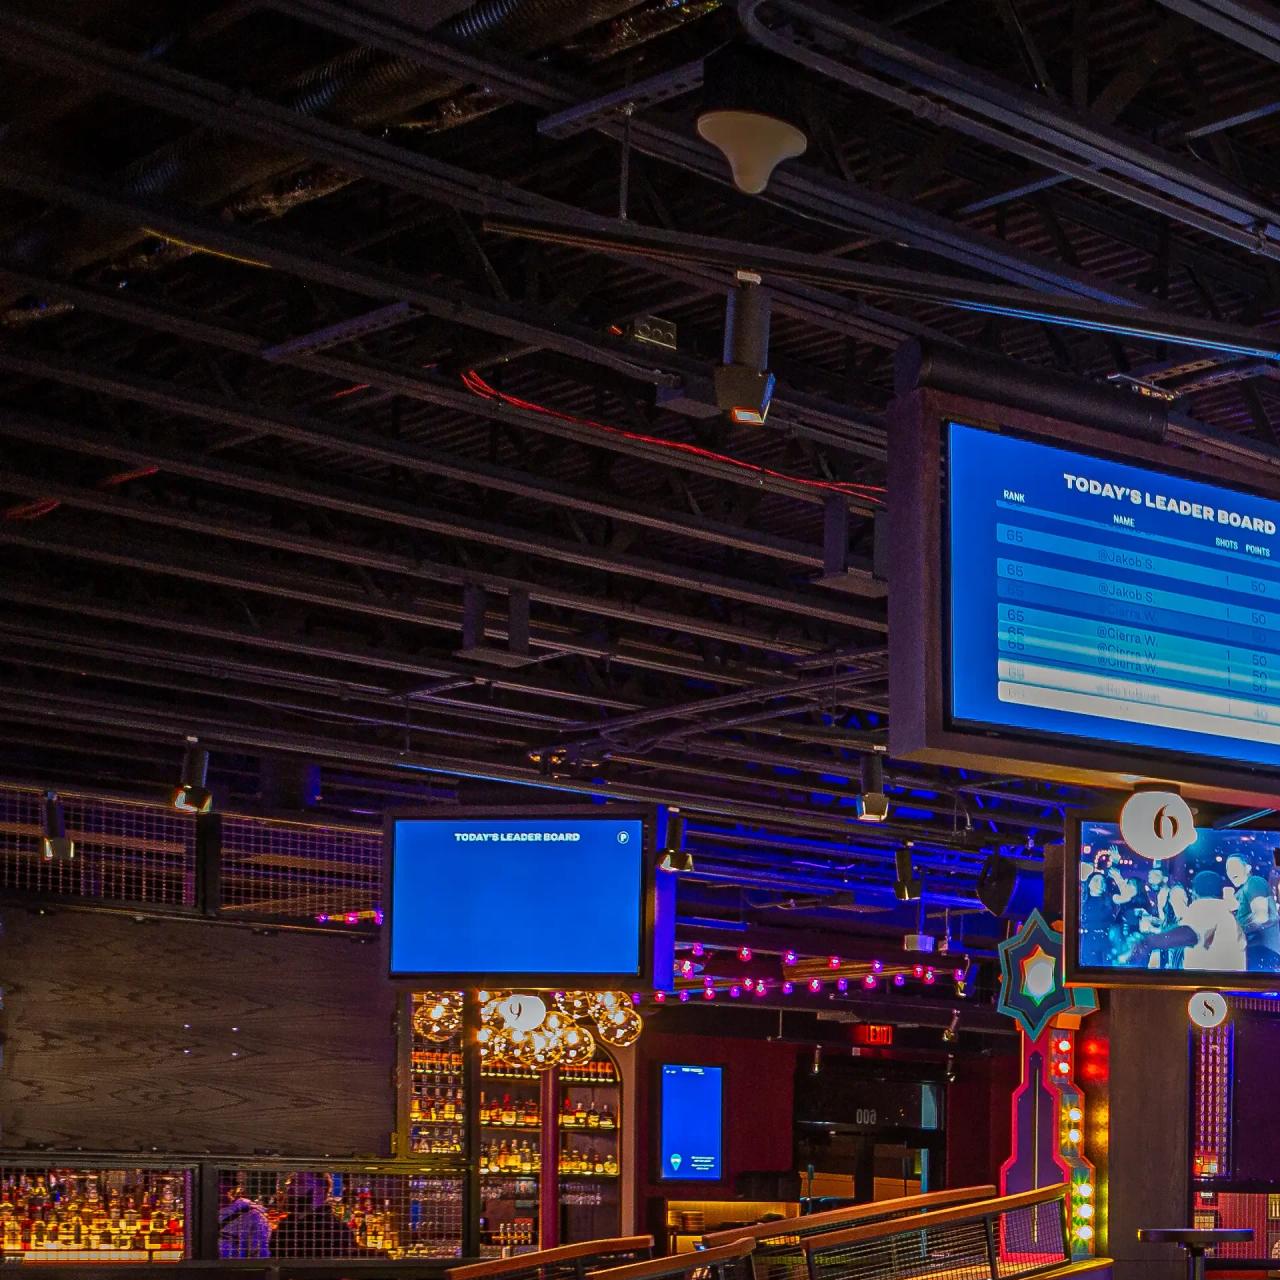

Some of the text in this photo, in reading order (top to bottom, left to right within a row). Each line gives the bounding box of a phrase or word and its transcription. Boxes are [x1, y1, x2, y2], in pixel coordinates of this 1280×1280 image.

[1003, 489, 1026, 503] RANK
[1113, 514, 1136, 528] NAME
[1215, 537, 1239, 551] SHOTS
[1245, 543, 1271, 558] POINTS
[1063, 473, 1277, 536] TODAY'S LEADER BOARD
[1006, 530, 1024, 543] 65
[1098, 548, 1143, 568] @Jakob
[1251, 581, 1266, 594] 50
[1007, 565, 1024, 577] 65
[1098, 582, 1144, 601] @Jakob
[1251, 612, 1267, 625] 50
[1007, 609, 1025, 622] 65
[1144, 633, 1159, 648] W.
[1252, 654, 1267, 666] 50
[454, 832, 581, 842] TODAY'S LEADER BOARD
[1153, 804, 1179, 841] 6
[870, 1025, 889, 1043] EXIT
